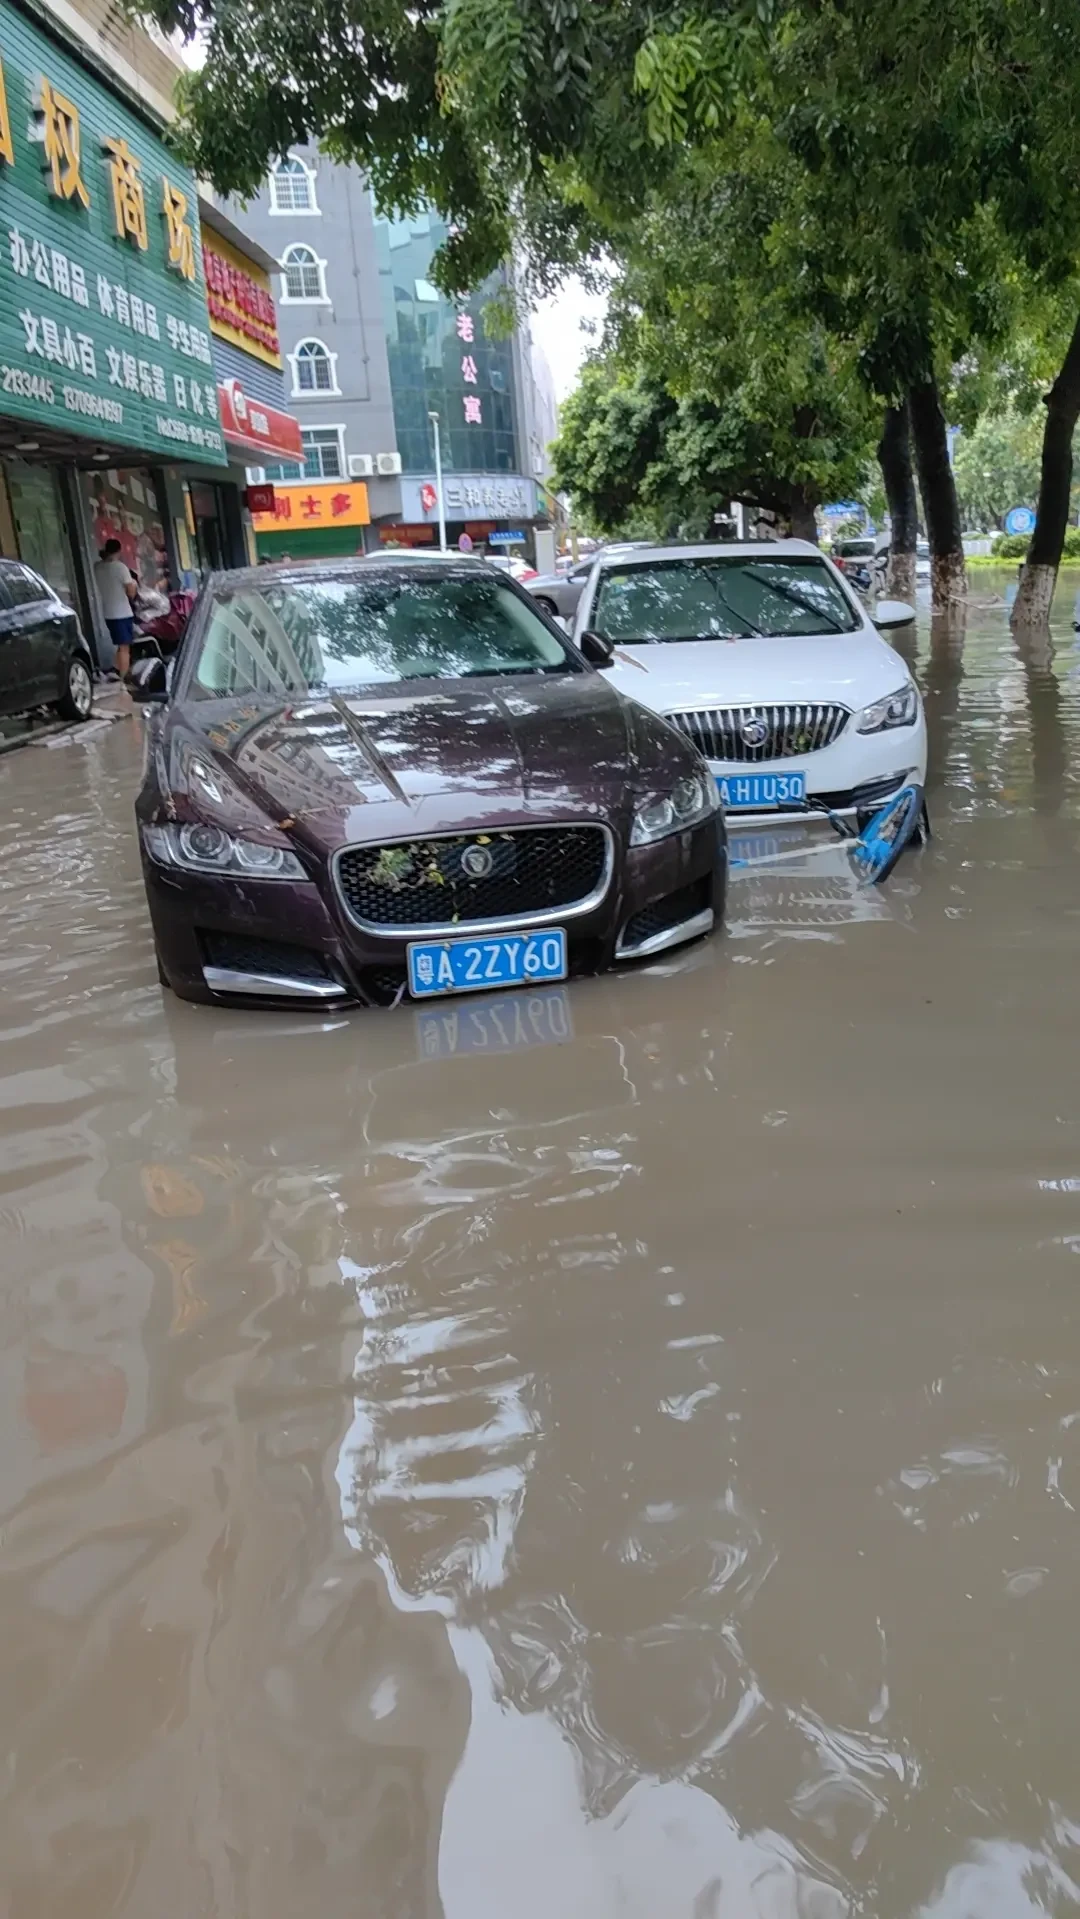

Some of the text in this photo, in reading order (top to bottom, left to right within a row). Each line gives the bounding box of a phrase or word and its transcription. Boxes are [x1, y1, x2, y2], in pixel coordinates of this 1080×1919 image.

[0, 57, 196, 282] 权商场
[9, 226, 89, 308] 办公用品
[97, 273, 161, 341] 体育用品
[166, 313, 212, 366] 学生用品
[18, 308, 97, 379] 文具小百
[105, 345, 167, 402] 文娱乐器
[456, 285, 482, 425] 老公寓
[252, 492, 352, 525] 利士多
